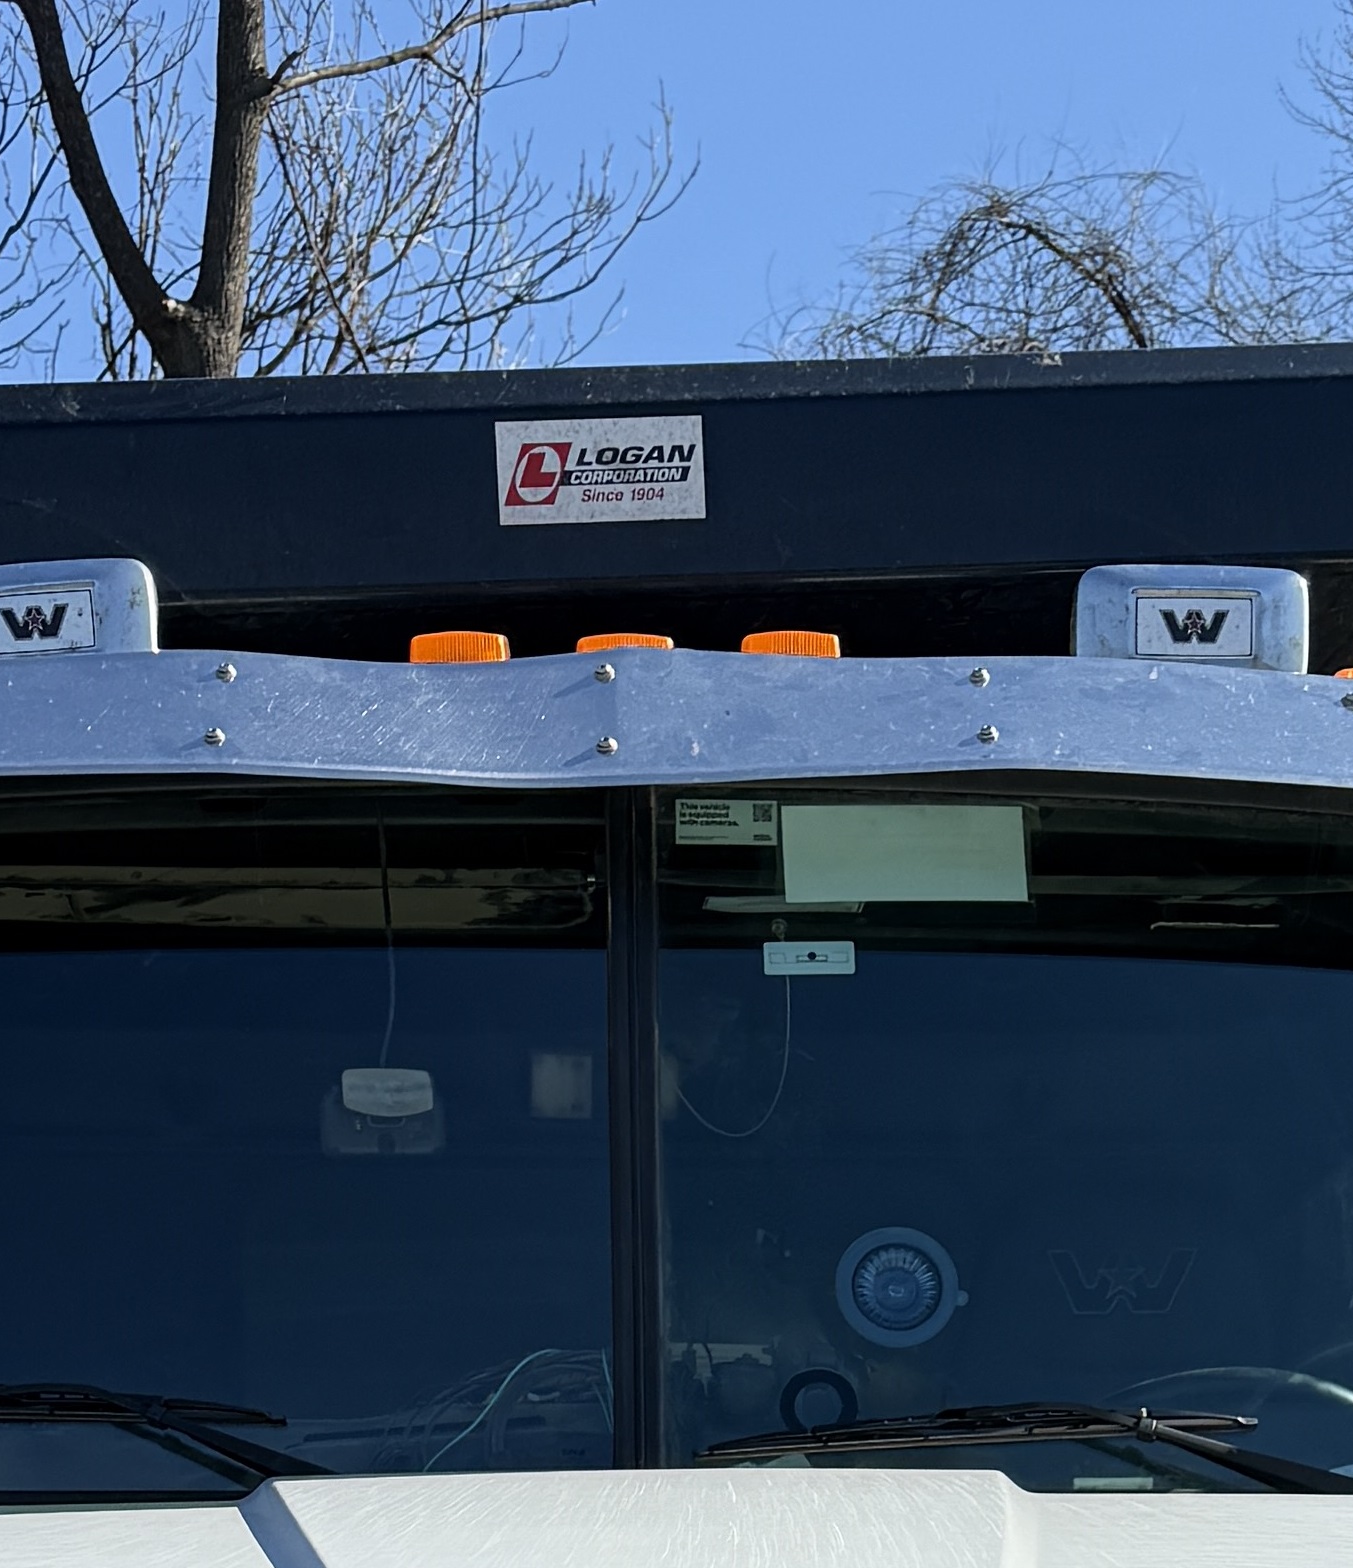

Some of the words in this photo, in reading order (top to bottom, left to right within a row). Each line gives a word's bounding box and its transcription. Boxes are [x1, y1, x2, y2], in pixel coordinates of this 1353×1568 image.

[575, 443, 697, 467] LOGAN
[570, 467, 683, 486] CORPORATION
[581, 488, 624, 503] Since
[631, 487, 665, 501] 1904
[1159, 608, 1230, 643] W
[680, 802, 698, 810] This
[689, 811, 730, 819] equipped
